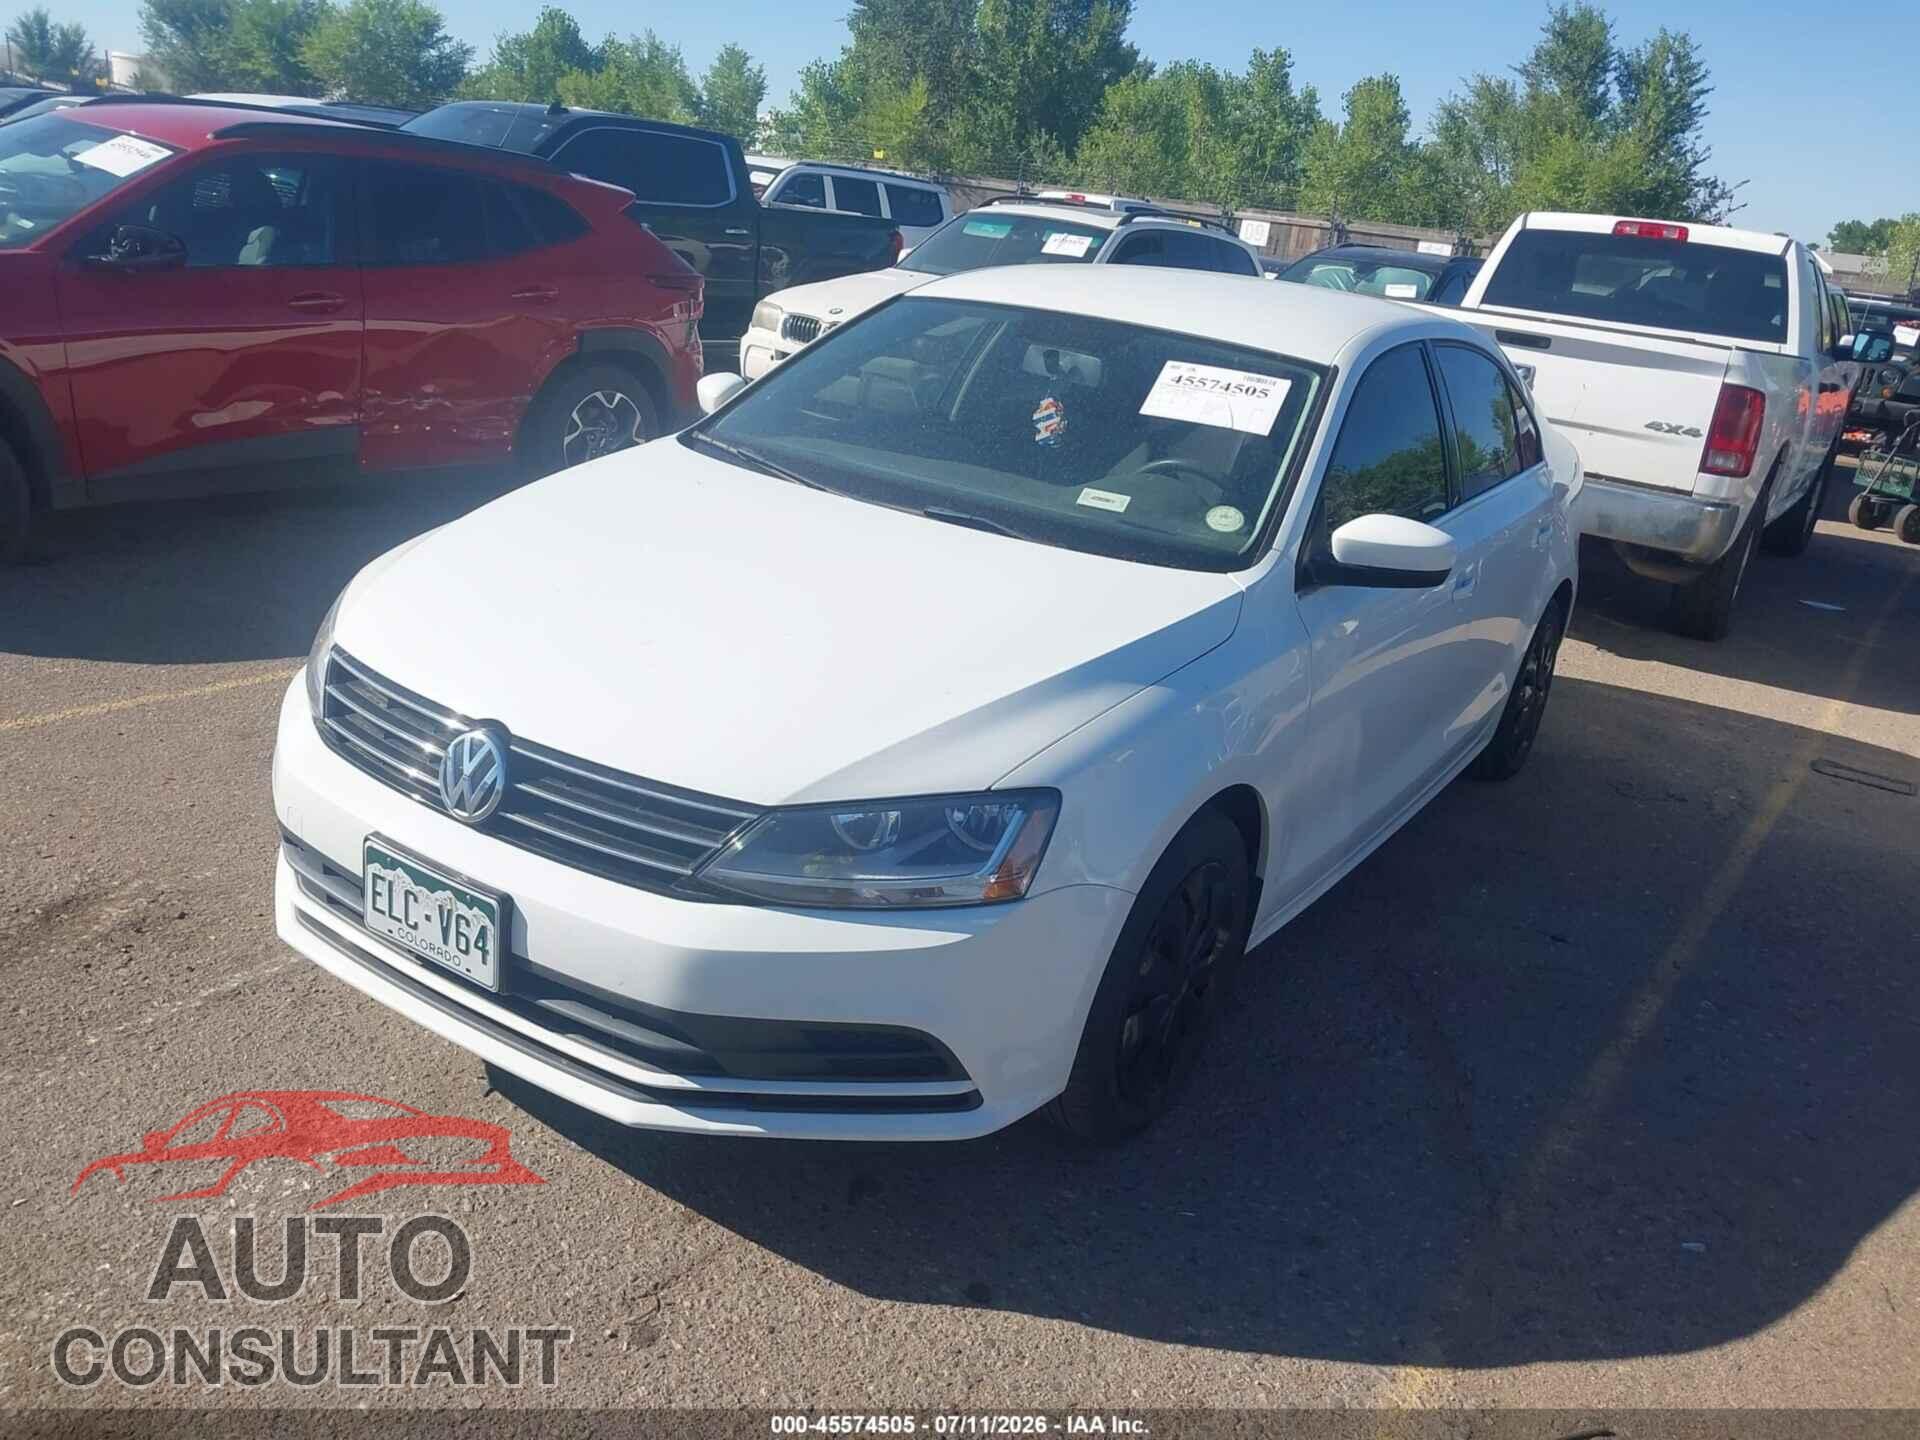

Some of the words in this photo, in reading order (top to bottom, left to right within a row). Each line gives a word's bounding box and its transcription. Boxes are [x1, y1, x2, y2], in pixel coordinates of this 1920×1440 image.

[1170, 374, 1271, 400] 45574505
[444, 732, 500, 818] VW
[396, 927, 463, 967] COLORADO
